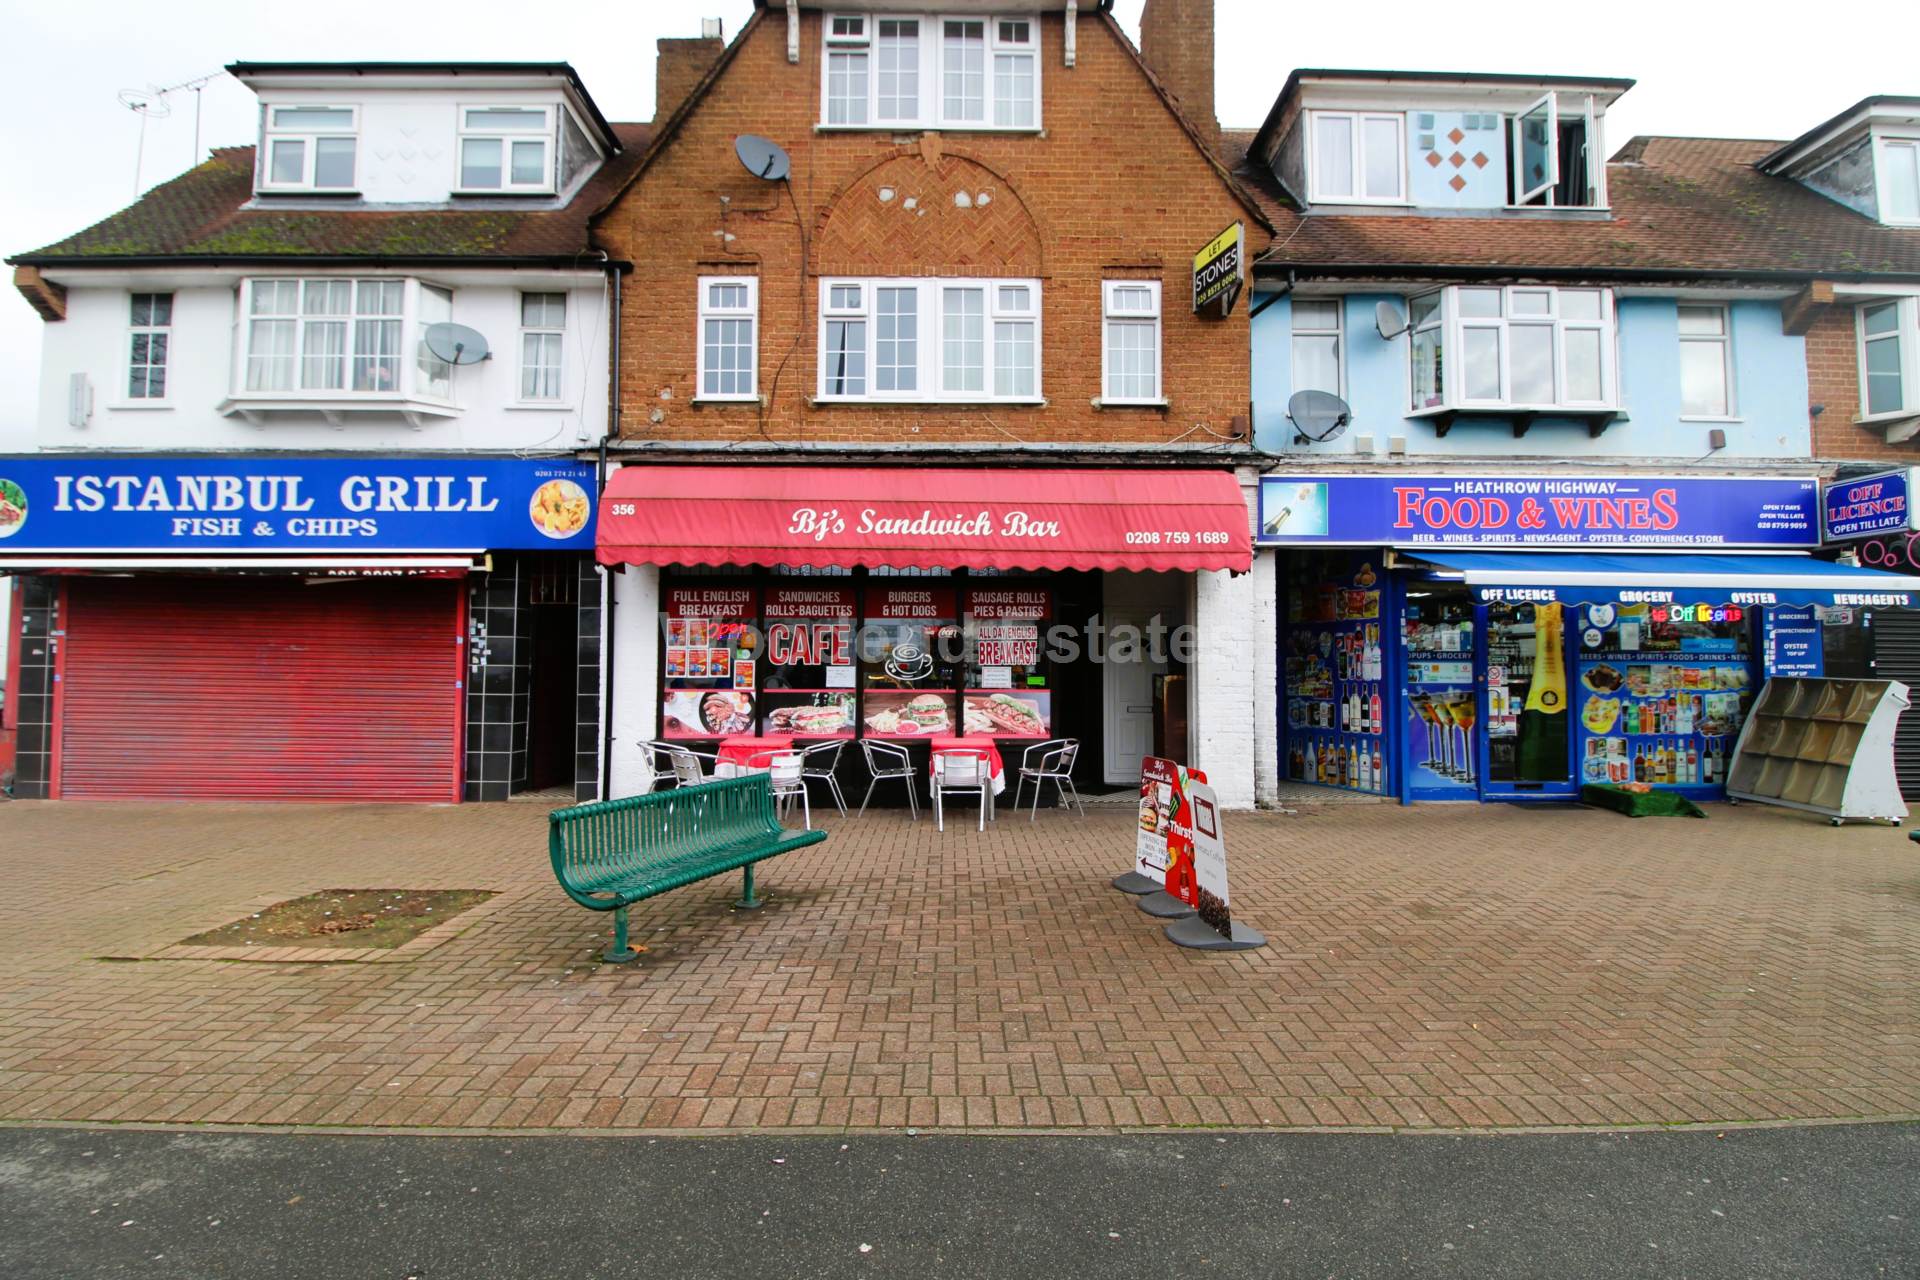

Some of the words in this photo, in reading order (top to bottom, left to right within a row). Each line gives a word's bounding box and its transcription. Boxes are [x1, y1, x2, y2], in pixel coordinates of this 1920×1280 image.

[1208, 240, 1221, 258] LET
[1196, 248, 1238, 292] STONES
[53, 475, 315, 512] ISTANBUL
[339, 475, 499, 512] GRILL
[1454, 482, 1541, 494] HEATHROW
[1544, 482, 1617, 494] HIGHWAY
[1848, 483, 1883, 503] OFF
[612, 504, 635, 516] 356
[1393, 487, 1510, 529] FOOD
[1516, 497, 1546, 529] &
[1549, 488, 1679, 531] WINES
[1828, 496, 1905, 523] LICENCE
[172, 518, 242, 537] FISH
[253, 521, 276, 537] &
[286, 518, 378, 537] CHIPS
[788, 508, 845, 542] Bj's
[856, 508, 993, 536] Sandwich
[1000, 511, 1060, 537] Bar
[1834, 522, 1858, 534] OPEN
[1860, 519, 1878, 530] TILL
[1879, 516, 1900, 527] LATE
[1126, 531, 1160, 544] 0208
[1164, 531, 1190, 544] 759
[1194, 532, 1229, 544] 1689
[1413, 534, 1435, 542] BEER
[1443, 534, 1473, 542] WINES
[1481, 534, 1516, 542] SPIRITS
[1523, 534, 1581, 543] NEWSAGENT
[1629, 534, 1694, 544] CONVENIENCE
[1695, 535, 1724, 544] STORE
[673, 590, 699, 602] FULL
[703, 590, 750, 602] ENGLISH
[778, 591, 840, 603] SANDWICHES
[888, 591, 932, 603] BURGERS
[972, 592, 1014, 604] SAUSAGE
[1016, 592, 1046, 604] ROLLS
[1481, 588, 1503, 600] OFF
[1505, 588, 1556, 601] LICENCE
[1619, 590, 1673, 602] GROCERY
[1731, 592, 1776, 603] OYSTER
[1833, 593, 1909, 605] NEWSAGENTS
[679, 604, 744, 616] BREAKFAST
[766, 605, 853, 617] ROLLS-BAGUETTES
[882, 605, 890, 616] &
[891, 605, 910, 616] HOT
[912, 605, 937, 617] DOGS
[973, 606, 997, 617] PIES
[998, 606, 1003, 617] &
[1005, 606, 1044, 617] PASTIES
[709, 622, 748, 640] Open
[979, 626, 992, 639] ALL
[993, 626, 1006, 639] DAY
[1007, 626, 1038, 639] ENGLISH
[768, 623, 851, 666] CAFE
[979, 641, 1037, 665] BREAKFAST
[1436, 652, 1472, 660] GROCERY
[1636, 653, 1664, 661] SPIRITS
[1668, 653, 1694, 661] FOODS
[1698, 653, 1726, 661] DRINKS
[1170, 820, 1195, 844] Thirsty
